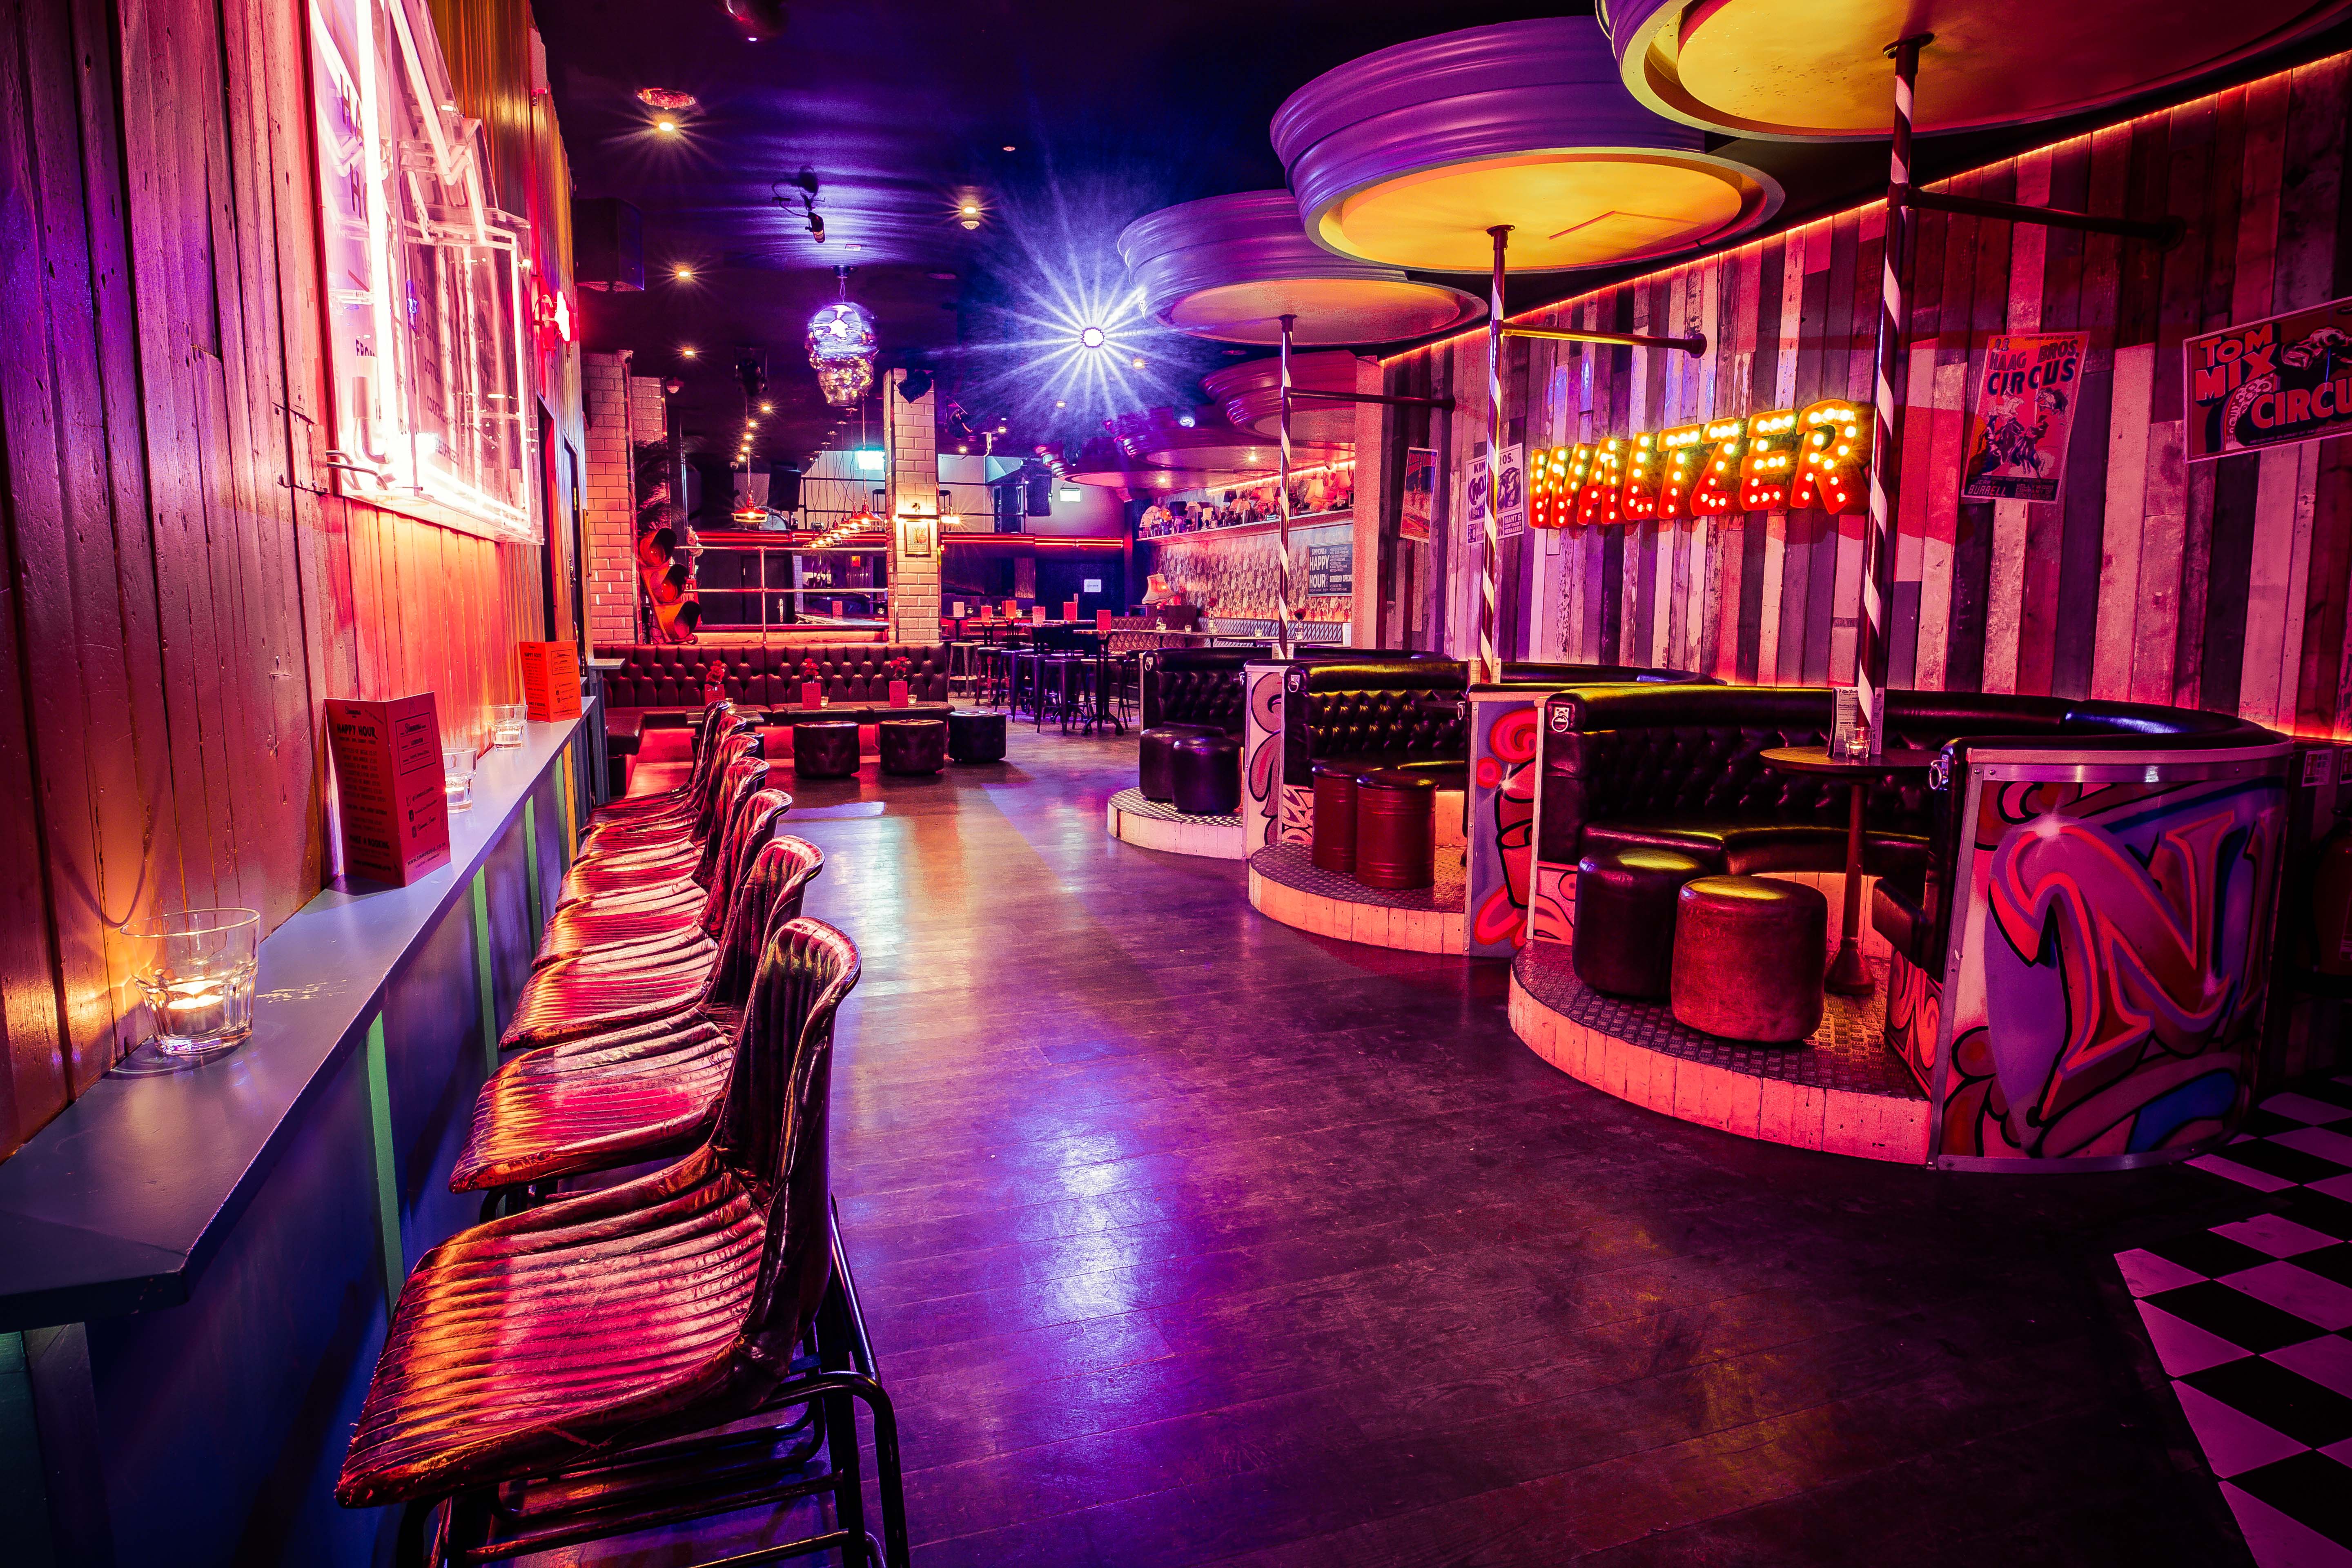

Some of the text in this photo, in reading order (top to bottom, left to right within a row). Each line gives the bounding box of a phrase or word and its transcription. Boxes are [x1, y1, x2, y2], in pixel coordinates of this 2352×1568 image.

[1989, 339, 2080, 371] HAAG BROS.
[2200, 323, 2274, 367] TOM
[1987, 357, 2076, 397] CIRCUS
[2195, 343, 2277, 401] MIX
[2251, 376, 2352, 429] CIRCU
[1529, 399, 1857, 528] WALTZER
[1505, 515, 1517, 523] GIANT
[1309, 555, 1330, 571] HAPPY
[1309, 574, 1326, 588] HOUR
[337, 723, 378, 740] HAPPY HOUR
